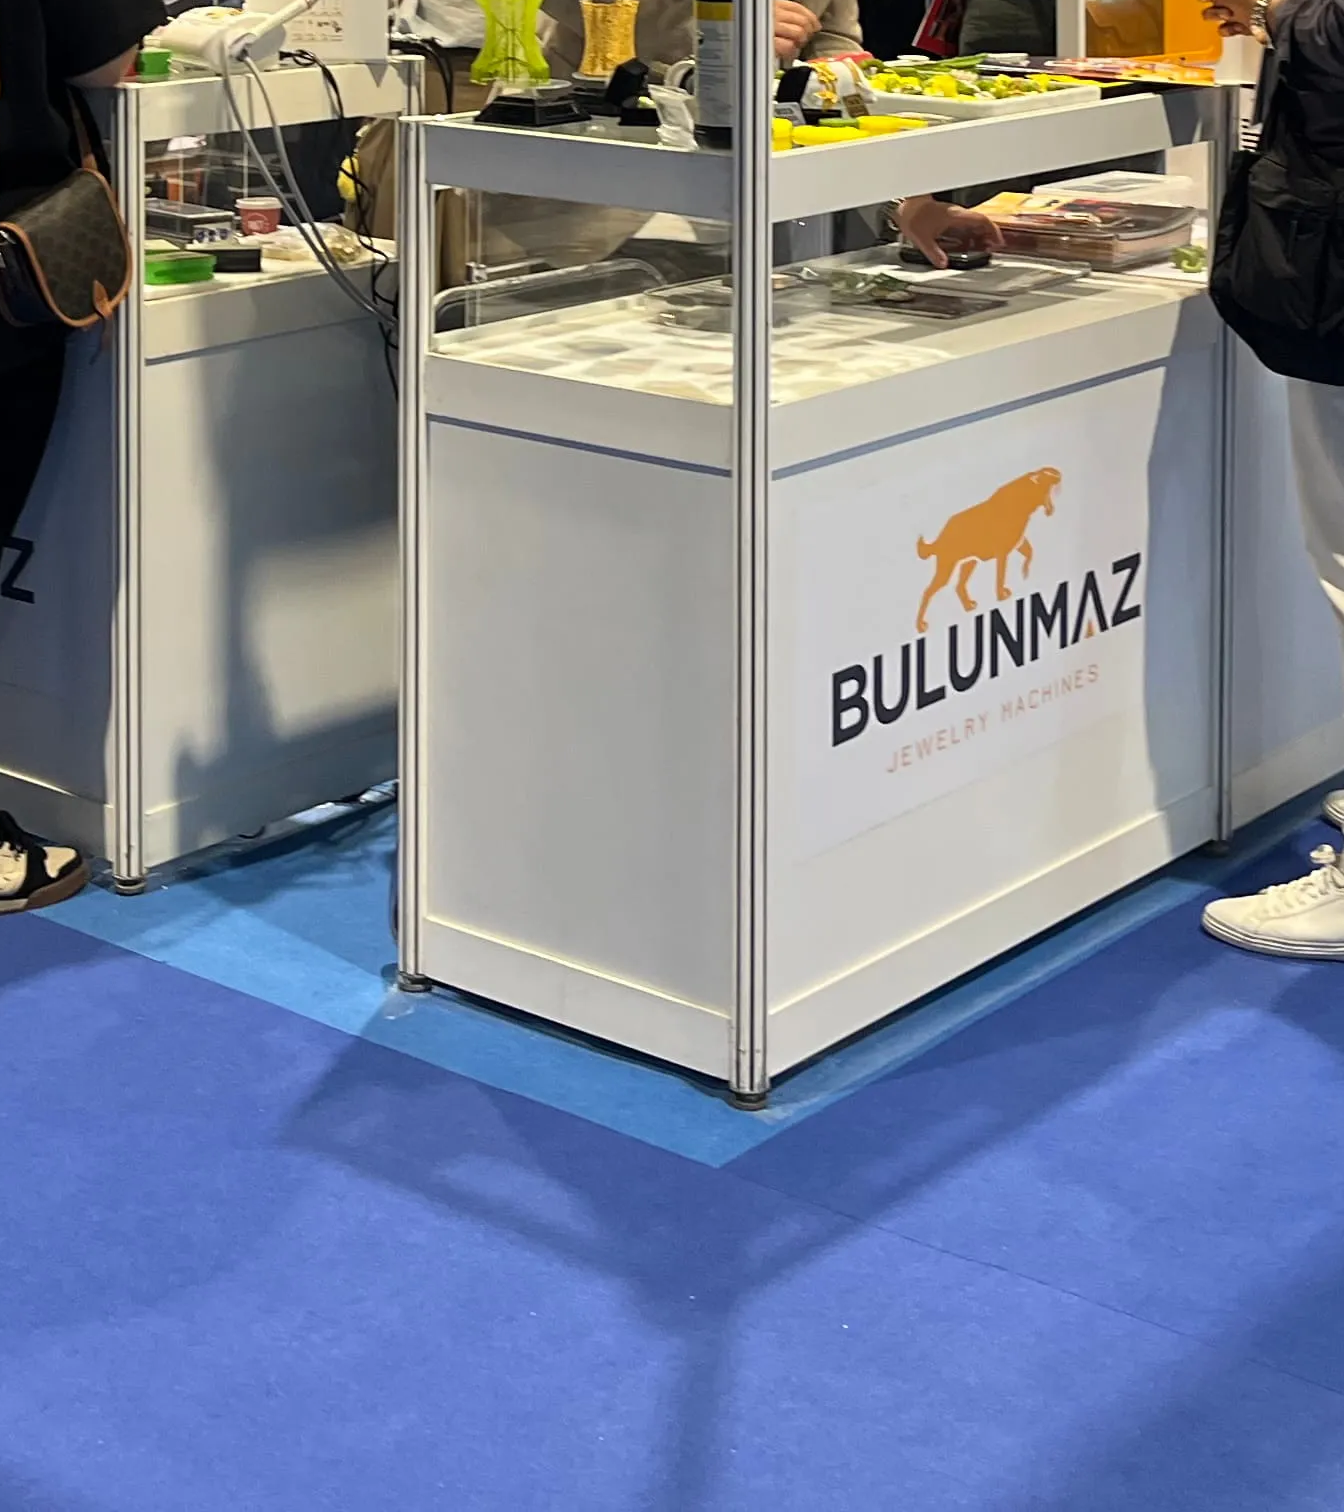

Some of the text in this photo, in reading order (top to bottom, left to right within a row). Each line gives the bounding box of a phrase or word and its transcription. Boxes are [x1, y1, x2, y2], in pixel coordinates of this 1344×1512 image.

[832, 551, 1142, 748] BULUNMAZ
[885, 662, 1101, 775] JEWELRY MACHINES
